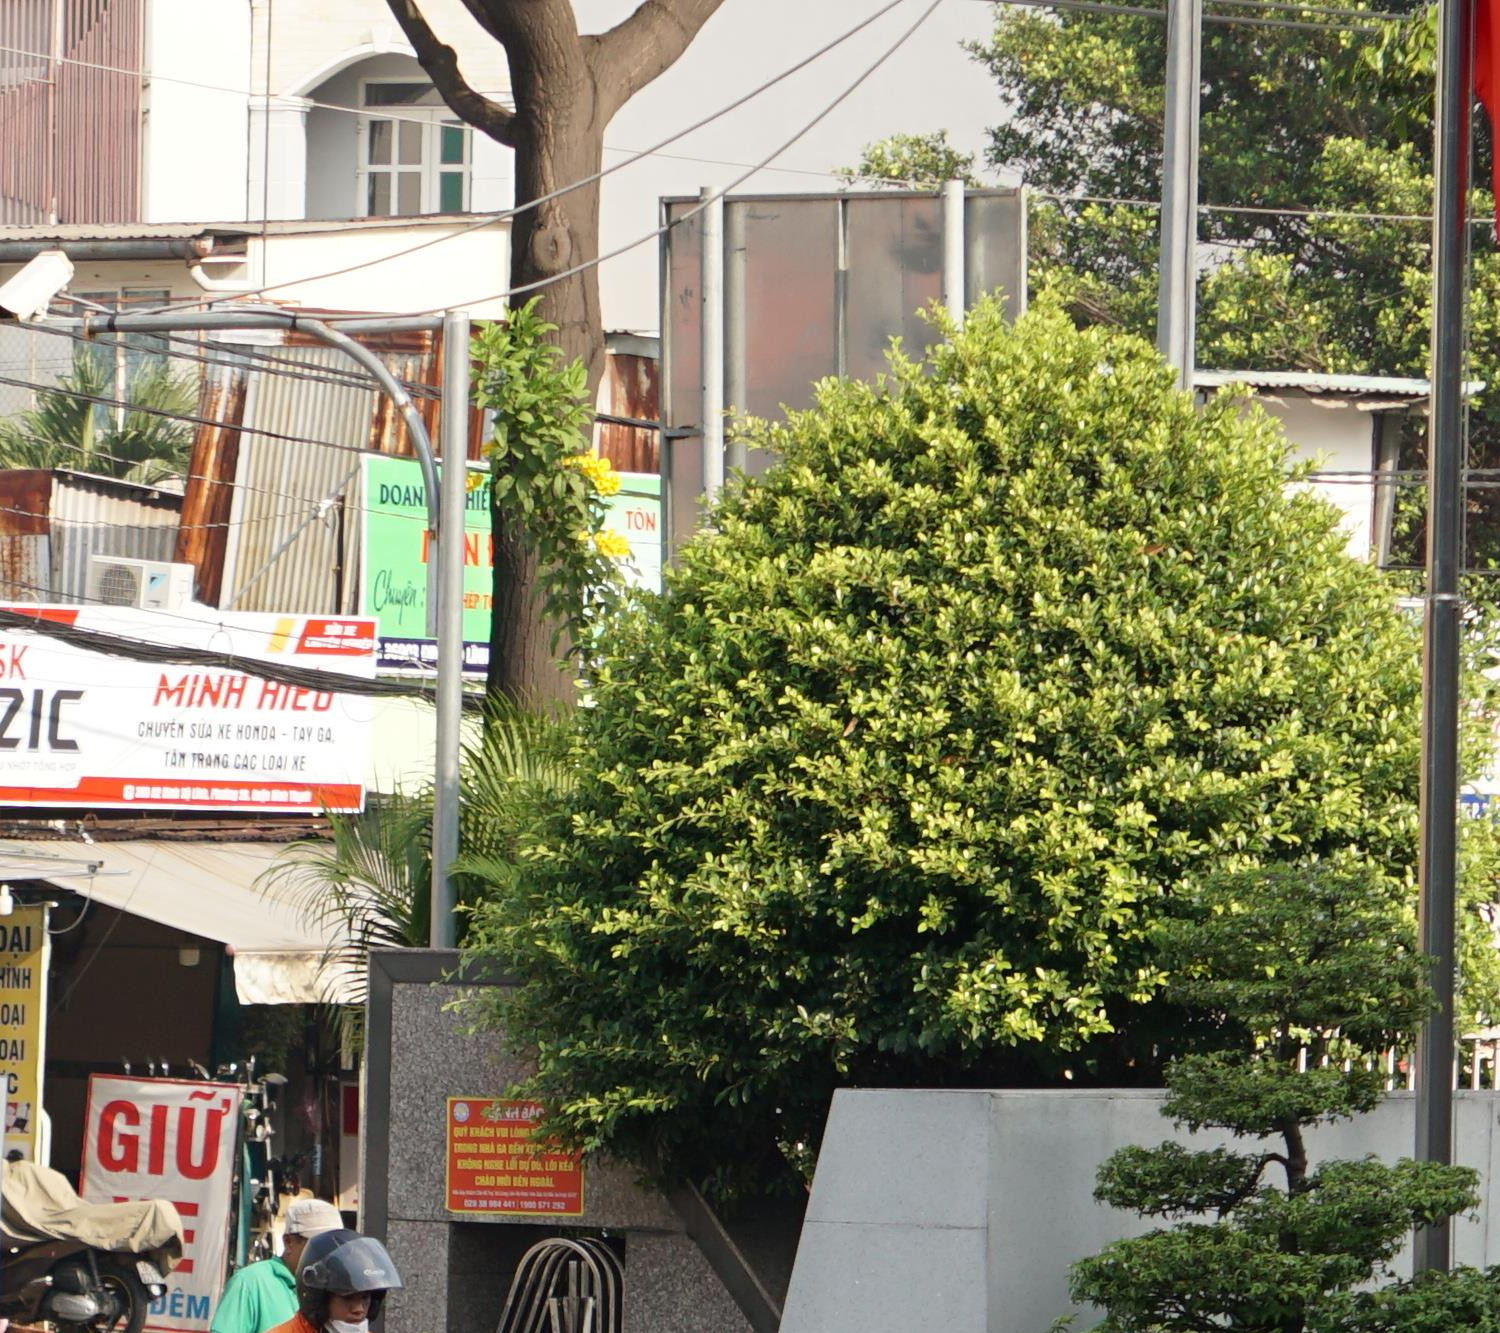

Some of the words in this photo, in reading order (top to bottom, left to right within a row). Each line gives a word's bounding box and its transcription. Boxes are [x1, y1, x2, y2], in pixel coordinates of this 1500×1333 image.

[153, 674, 244, 710] MINH
[237, 724, 276, 740] HONDA
[97, 1091, 232, 1180] GIỮ
[149, 1288, 210, 1320] ĐÊM
